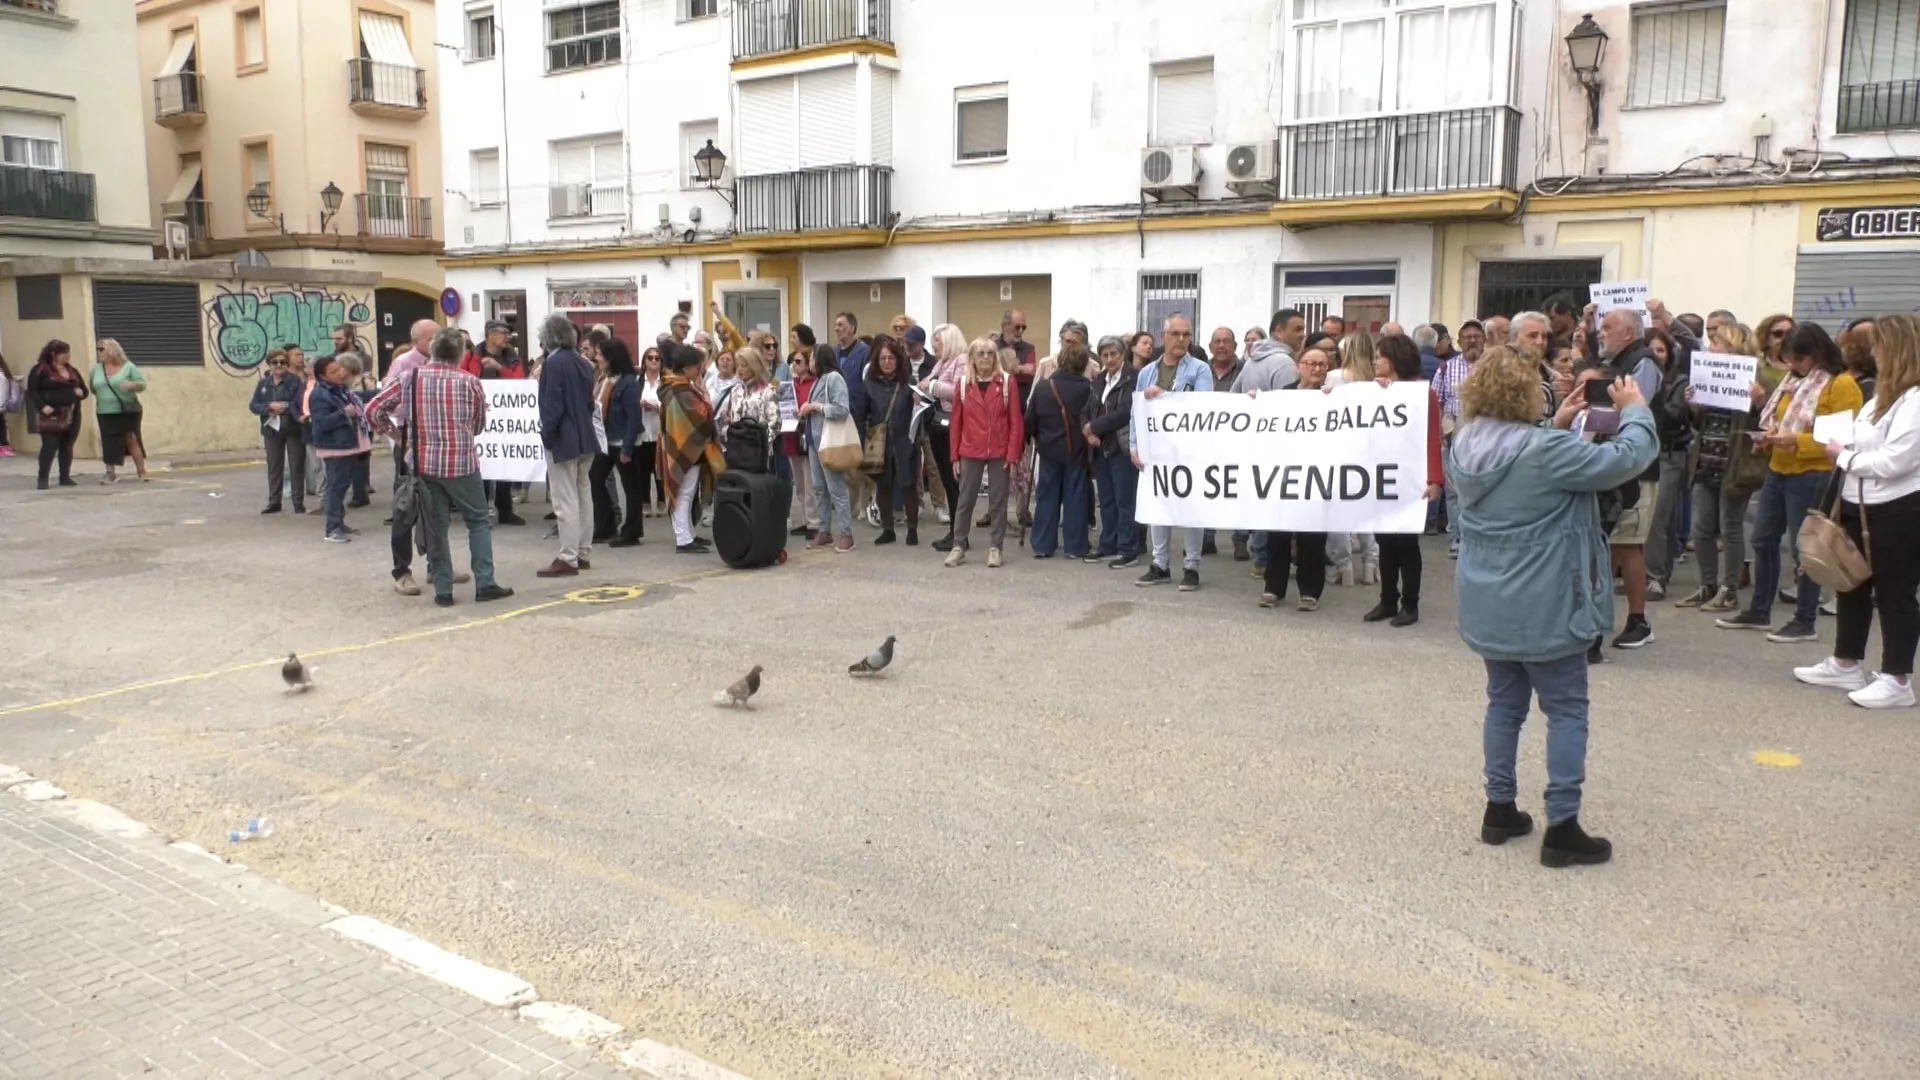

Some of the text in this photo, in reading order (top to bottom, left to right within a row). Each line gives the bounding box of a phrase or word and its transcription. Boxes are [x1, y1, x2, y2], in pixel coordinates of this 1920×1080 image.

[1602, 288, 1626, 296] CAMPO
[1703, 360, 1730, 369] CAMPO
[1711, 371, 1736, 380] BALAS
[1695, 383, 1708, 392] NO
[1710, 385, 1719, 394] SE
[492, 393, 537, 408] CAMPO
[1147, 403, 1408, 432] EL CAMPO DE LAS BALAS
[507, 419, 542, 434] BALAS
[486, 443, 499, 459] SE
[1153, 463, 1399, 501] NO SE VENDE
